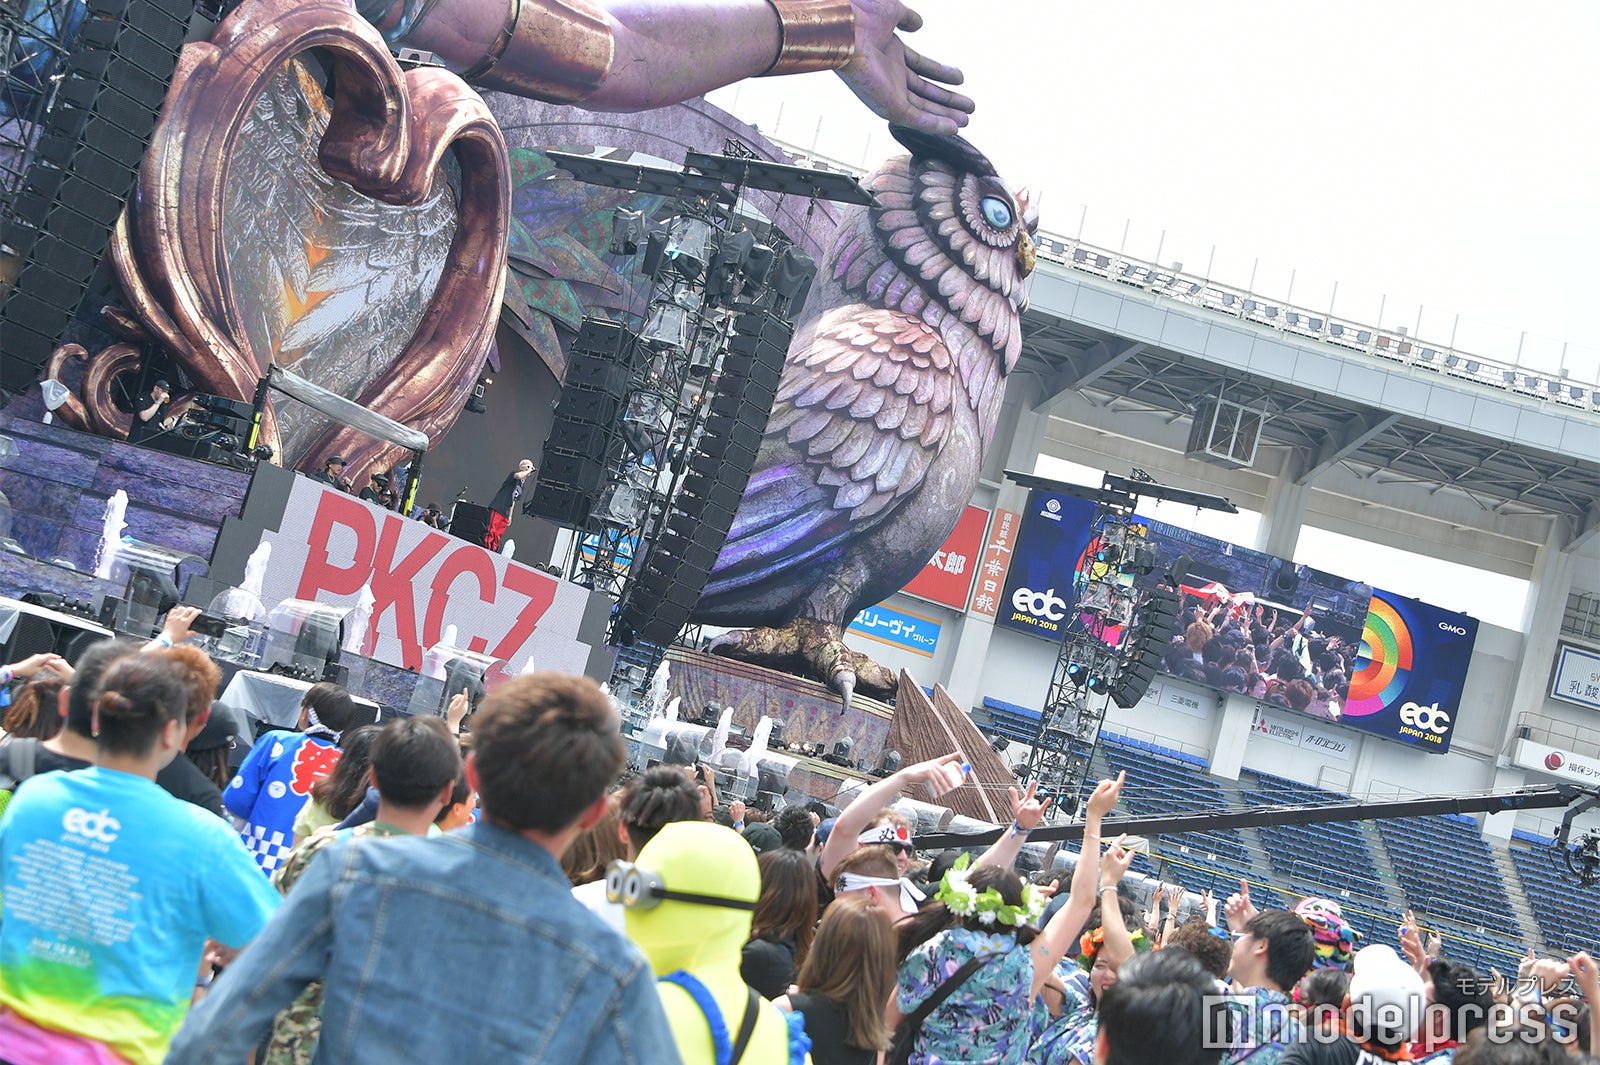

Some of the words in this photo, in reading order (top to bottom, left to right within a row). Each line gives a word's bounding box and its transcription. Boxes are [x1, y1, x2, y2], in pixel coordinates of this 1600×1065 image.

[975, 539, 1011, 613] 千葉日報
[1012, 587, 1067, 621] edc
[1011, 611, 1038, 626] JAPAN
[1039, 619, 1058, 632] 2018
[1438, 621, 1467, 637] GMO
[912, 633, 936, 646] グループ
[1569, 680, 1600, 700] 乳酸
[1170, 694, 1199, 710] 三菱電機
[1399, 701, 1450, 734] edc
[1268, 729, 1294, 742] ELECTRIC
[1270, 723, 1299, 737] MITSUBISHI
[1398, 725, 1424, 739] JAPAN
[1424, 732, 1443, 745] 2018
[62, 807, 122, 843] edc
[879, 827, 895, 842] 必
